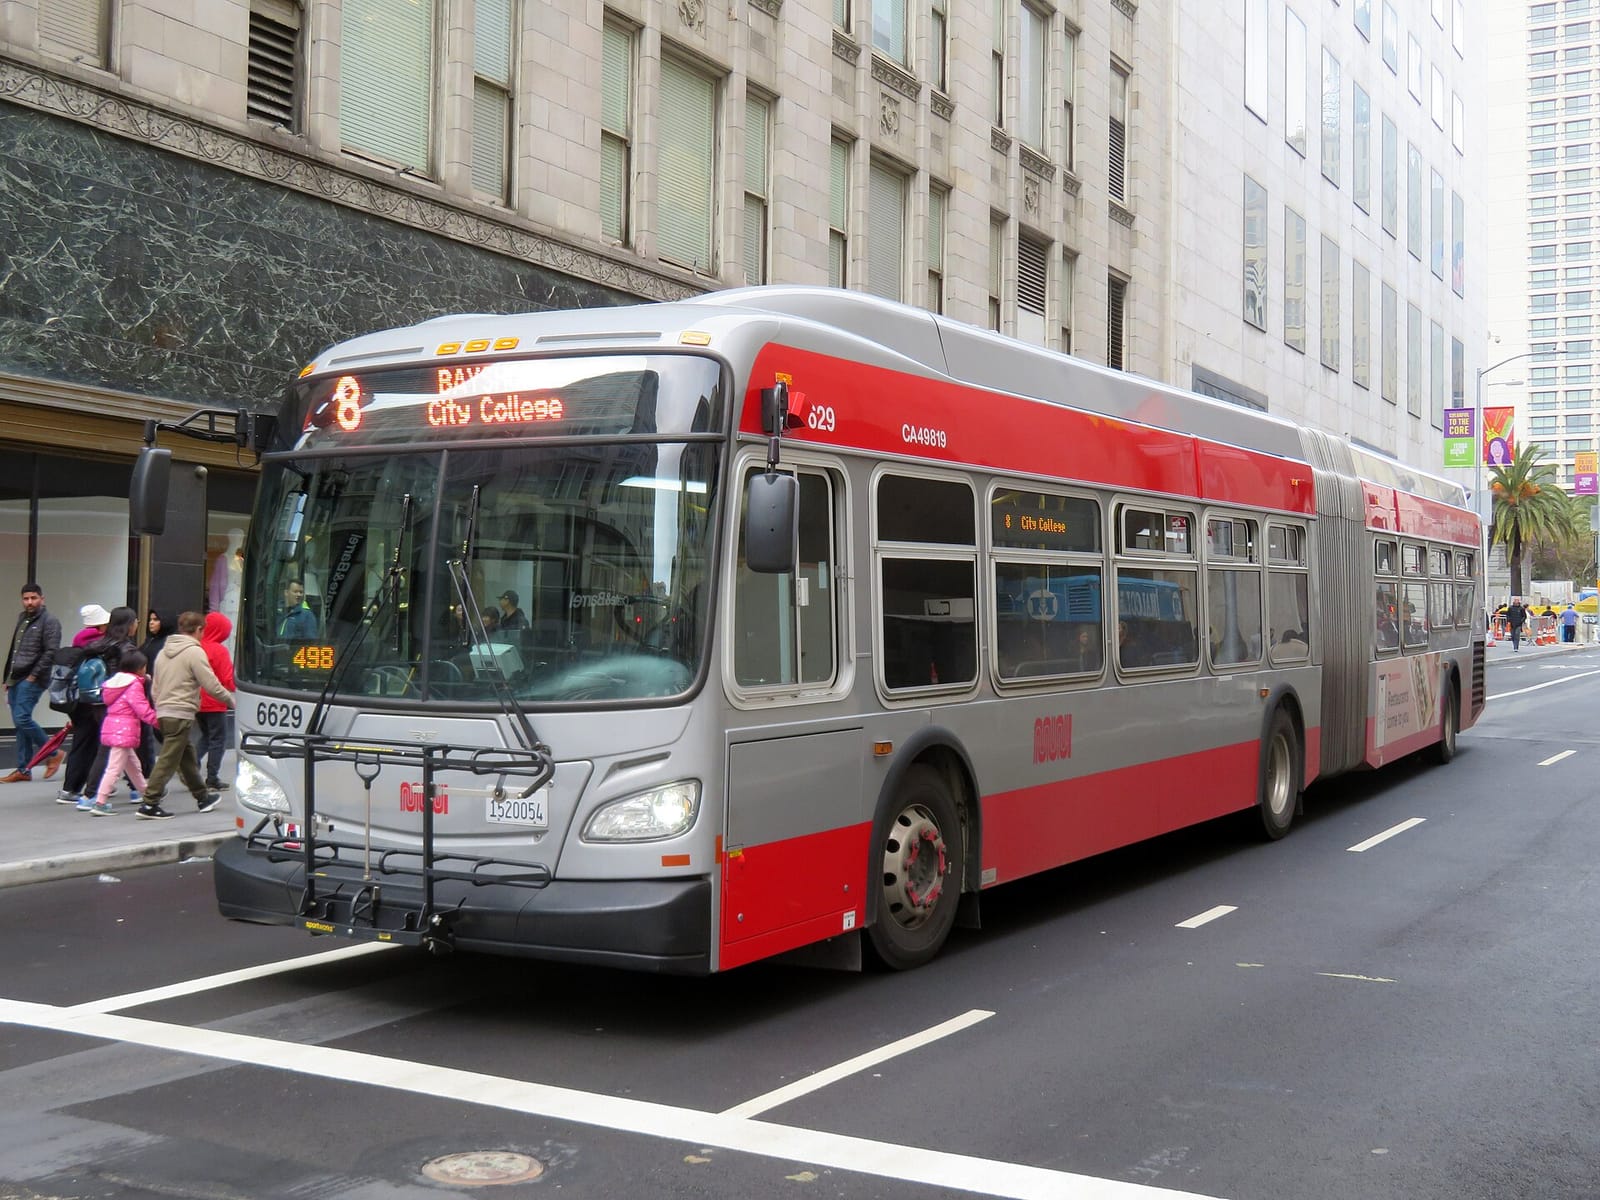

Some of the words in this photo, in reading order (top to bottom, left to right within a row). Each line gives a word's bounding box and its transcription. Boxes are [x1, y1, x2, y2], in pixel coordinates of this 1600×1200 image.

[335, 375, 361, 431] 8
[427, 399, 471, 427] City
[480, 394, 565, 424] College
[902, 423, 947, 449] CA49819
[1449, 425, 1470, 435] CORE
[1004, 513, 1012, 529] 8
[1021, 515, 1037, 530] City
[1039, 517, 1066, 533] College
[293, 646, 335, 669] 498
[257, 702, 303, 729] 6629
[489, 799, 543, 822] 1520054
